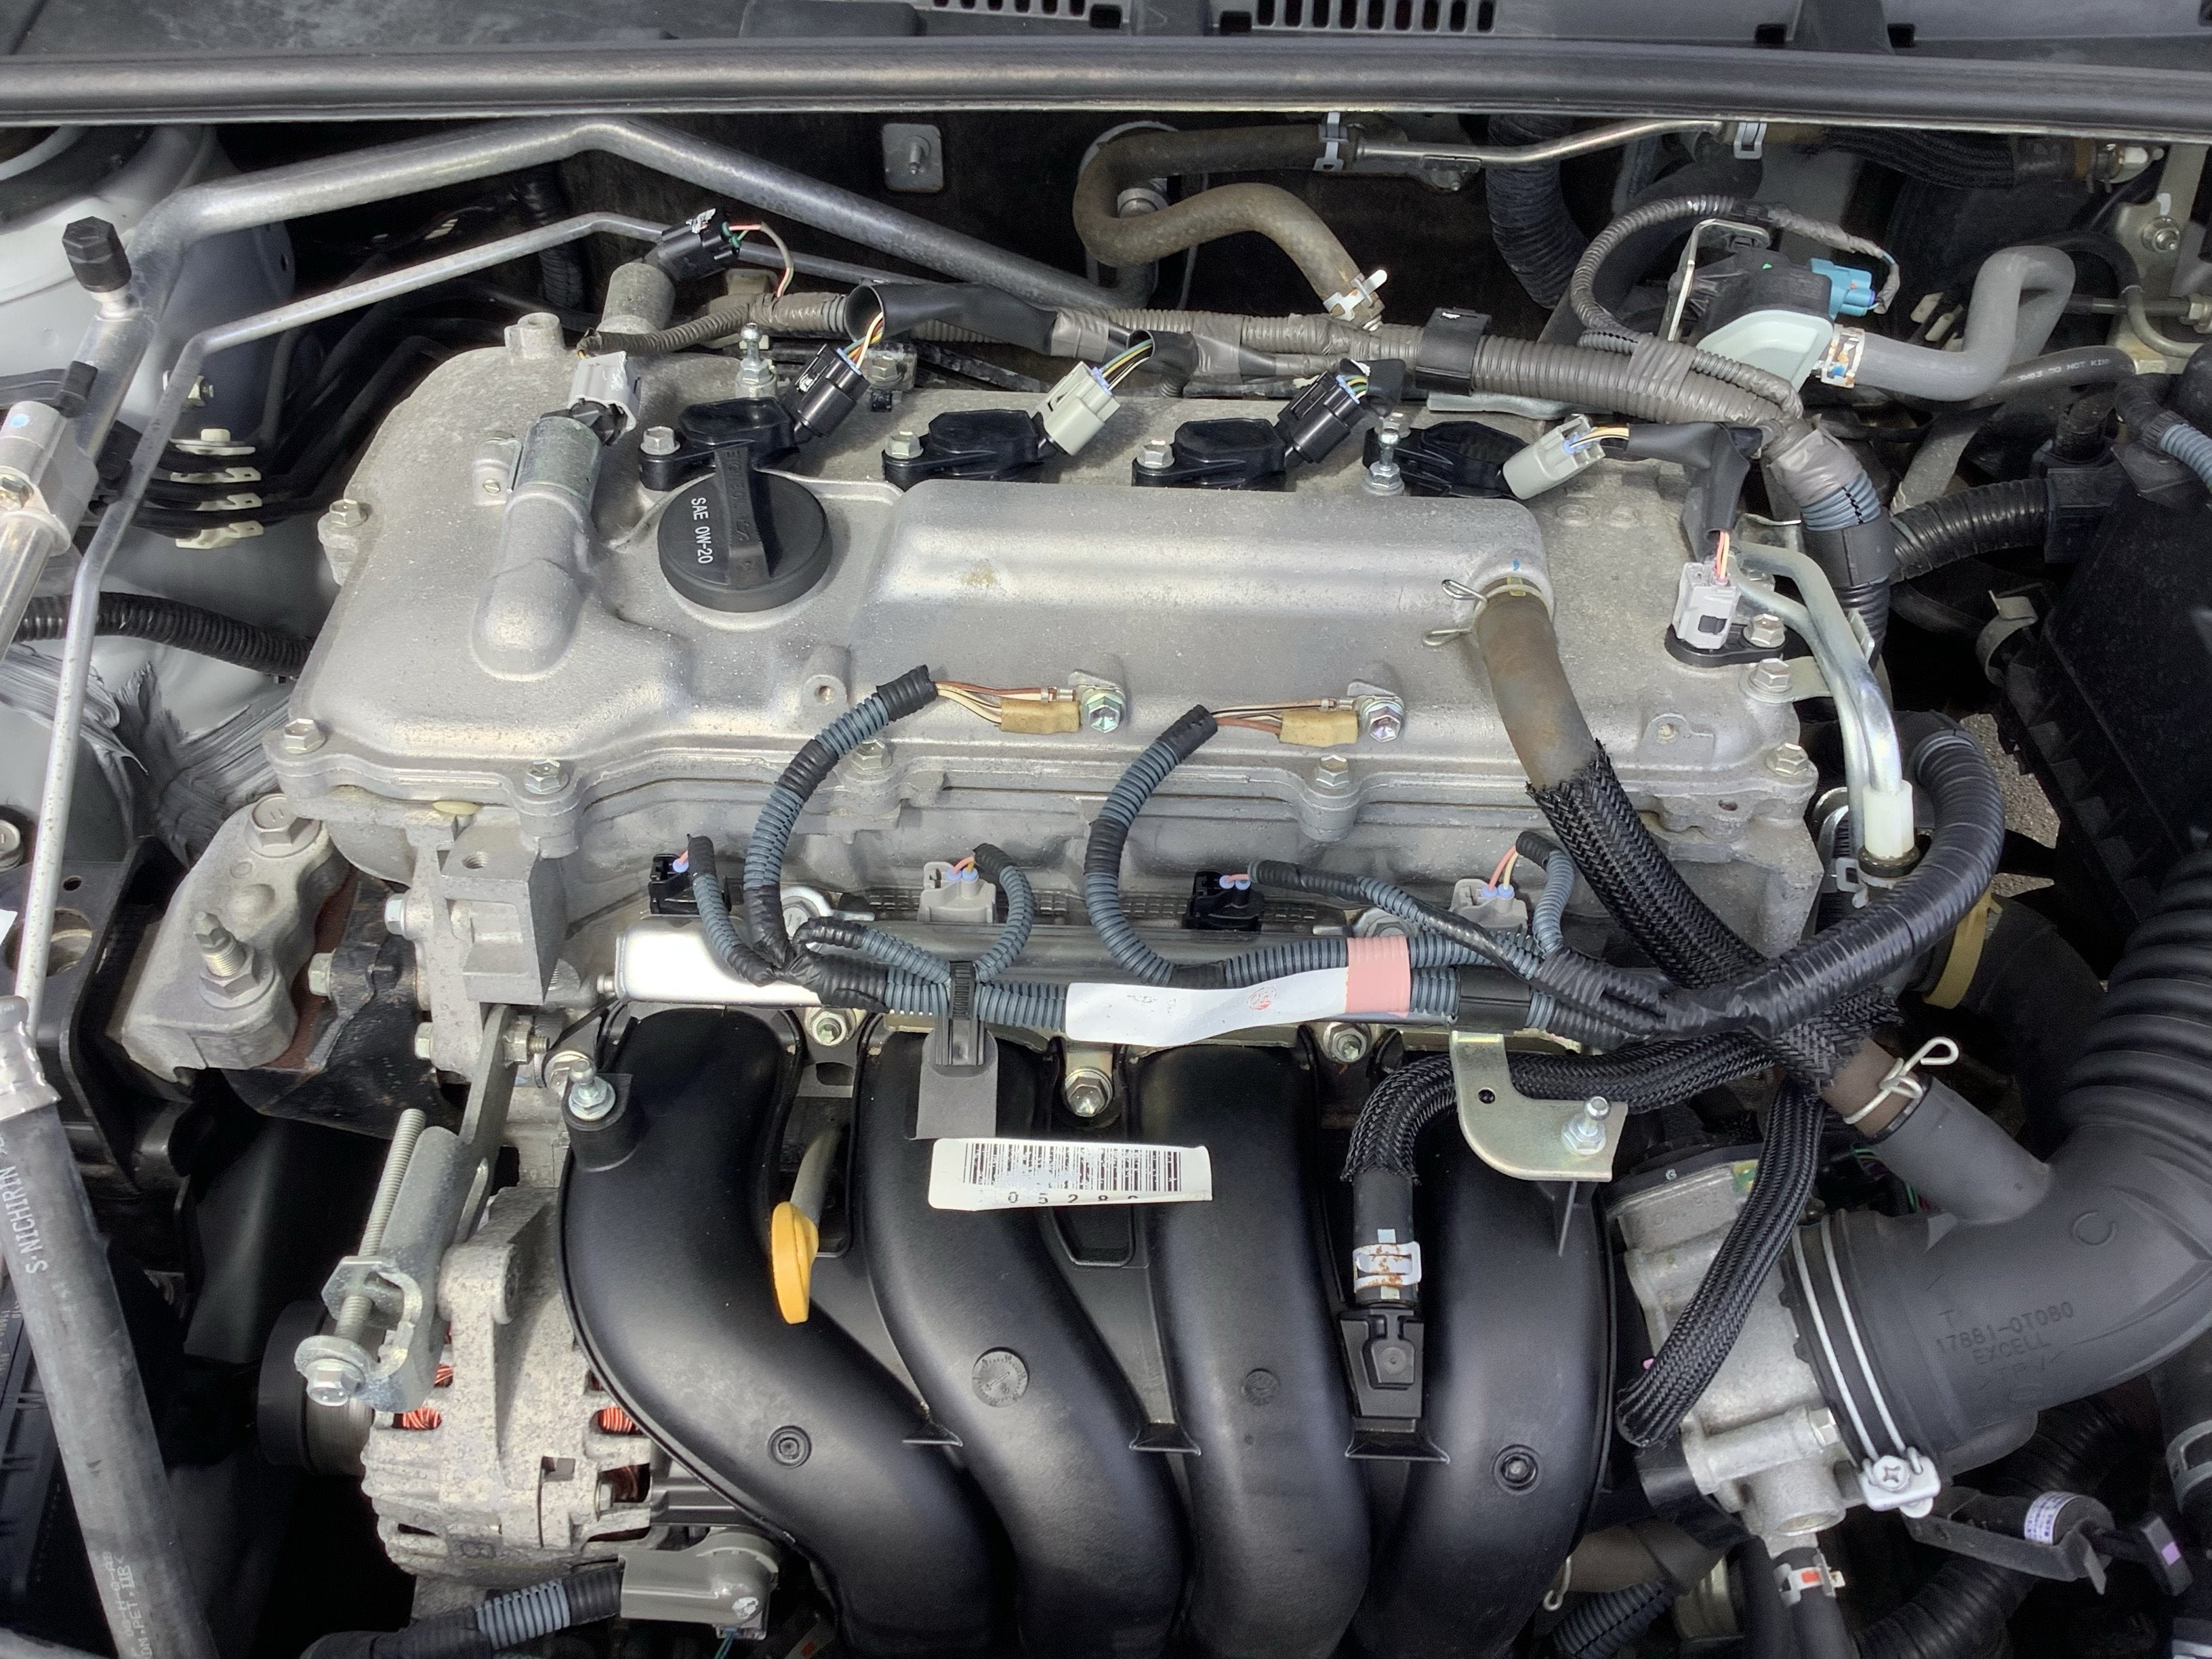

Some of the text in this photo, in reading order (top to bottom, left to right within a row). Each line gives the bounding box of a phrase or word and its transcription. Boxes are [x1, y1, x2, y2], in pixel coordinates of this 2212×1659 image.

[2067, 361, 2087, 371] NOT
[691, 497, 714, 564] SAE 0W-20
[1936, 1300, 2074, 1355] 17881-0T080
[1971, 1332, 2051, 1366] EXCELL
